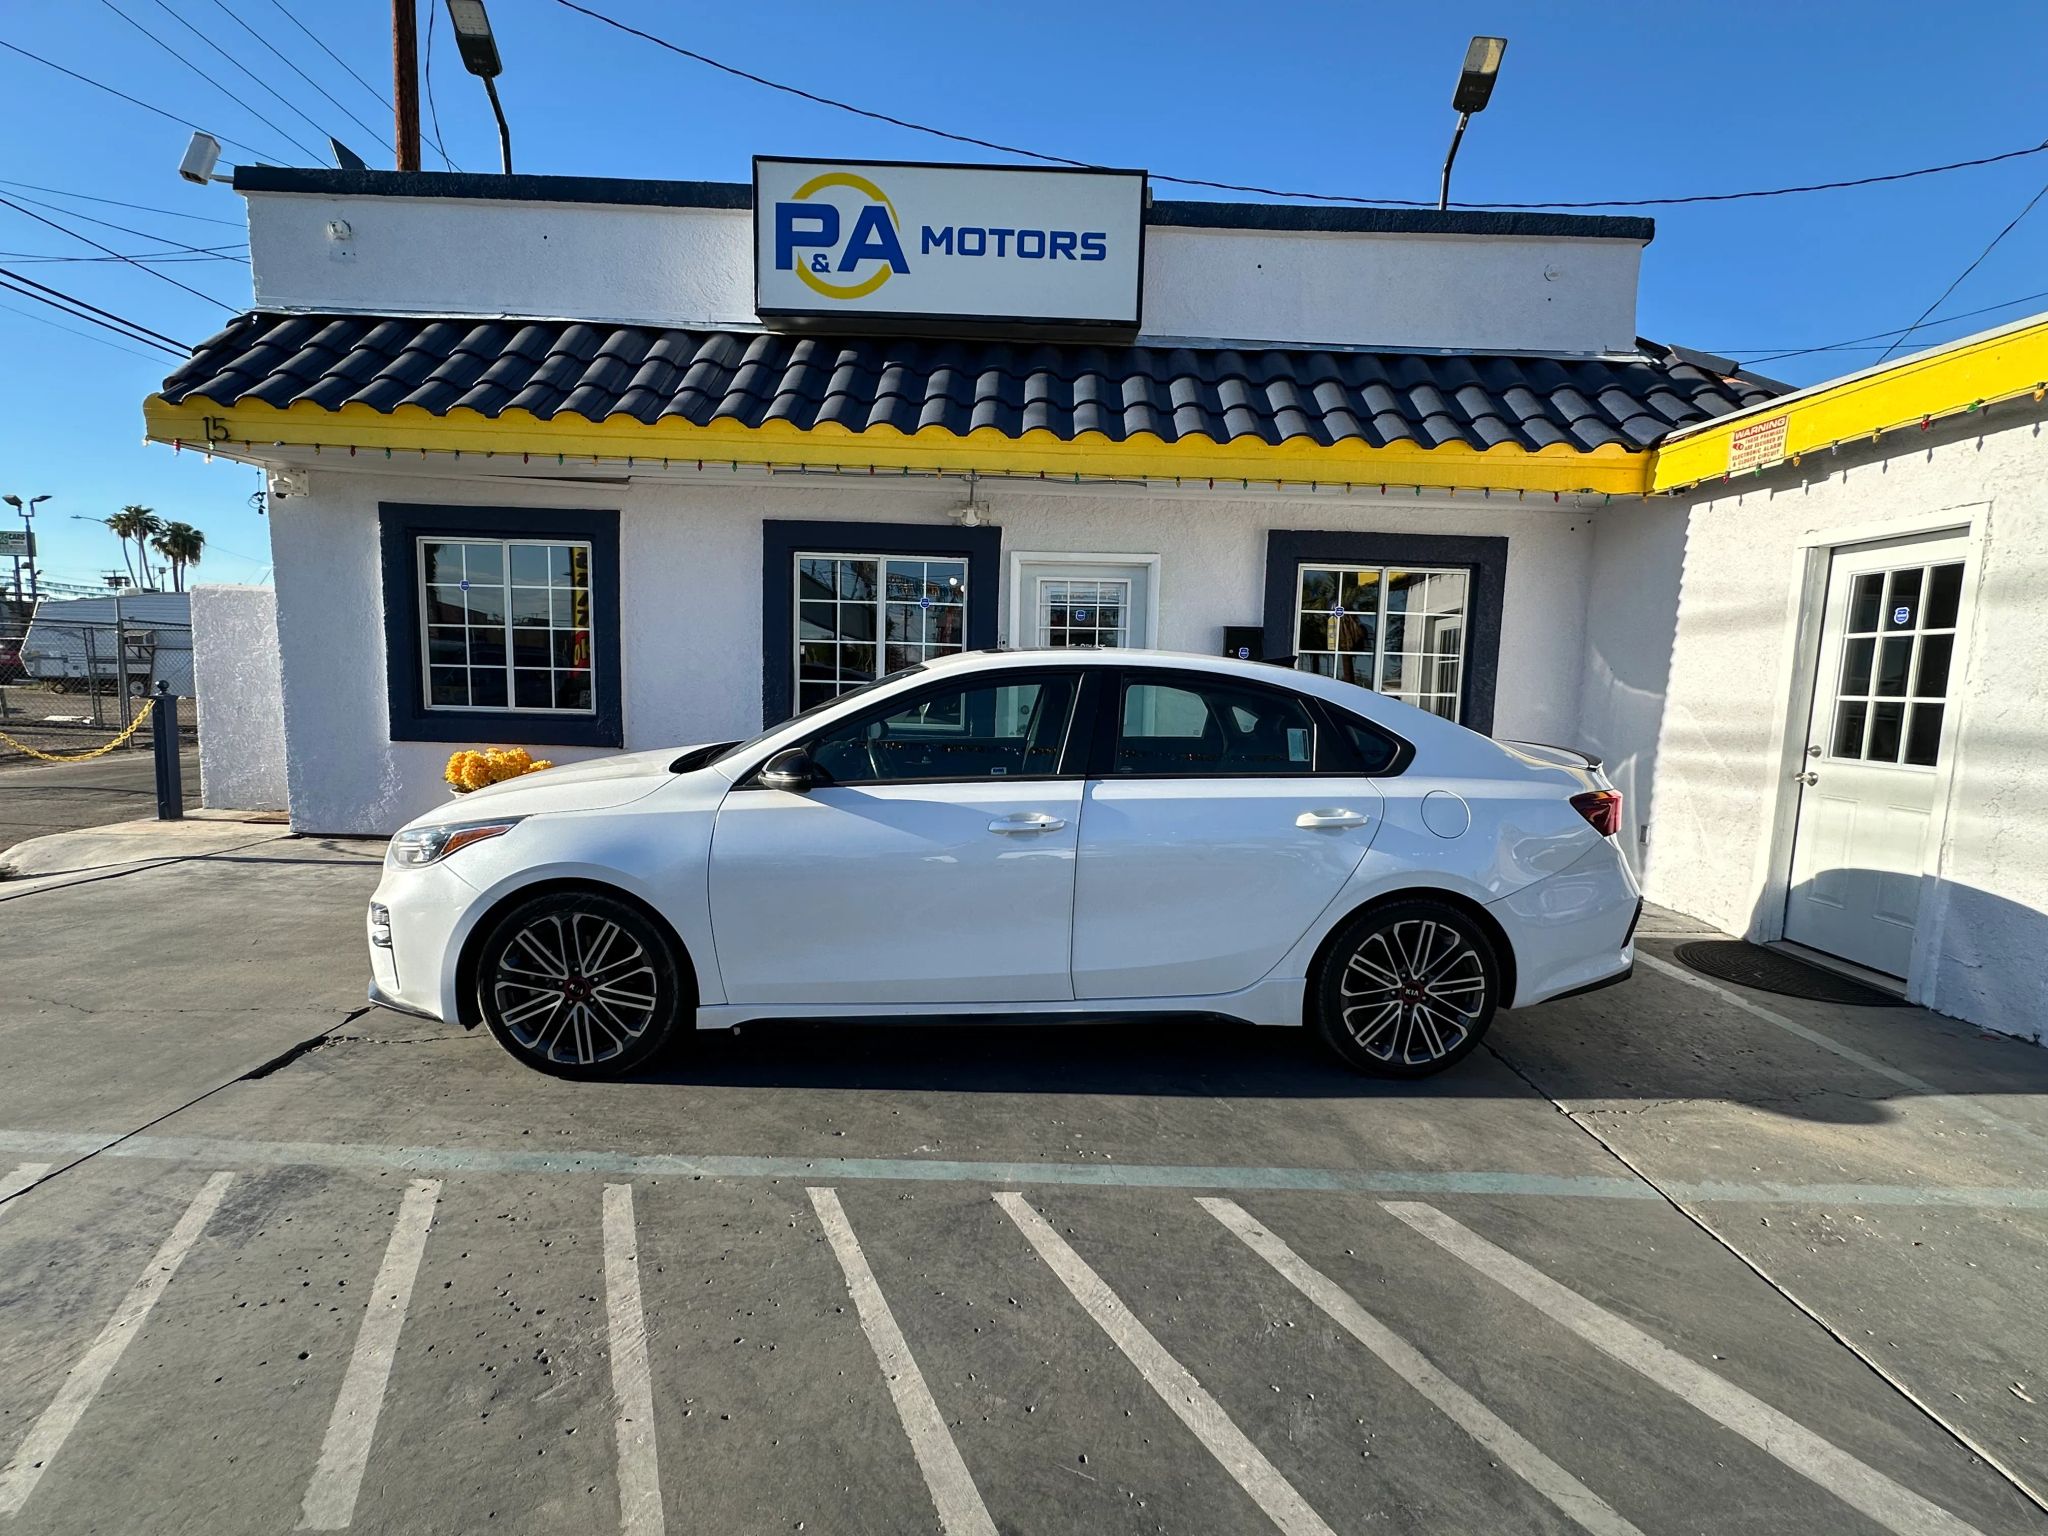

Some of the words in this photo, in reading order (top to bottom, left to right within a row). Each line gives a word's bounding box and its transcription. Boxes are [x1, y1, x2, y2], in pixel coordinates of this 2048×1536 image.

[921, 225, 1106, 261] MOTORS
[202, 416, 229, 441] 15
[1735, 418, 1785, 440] WARNING
[1405, 988, 1419, 996] KIA
